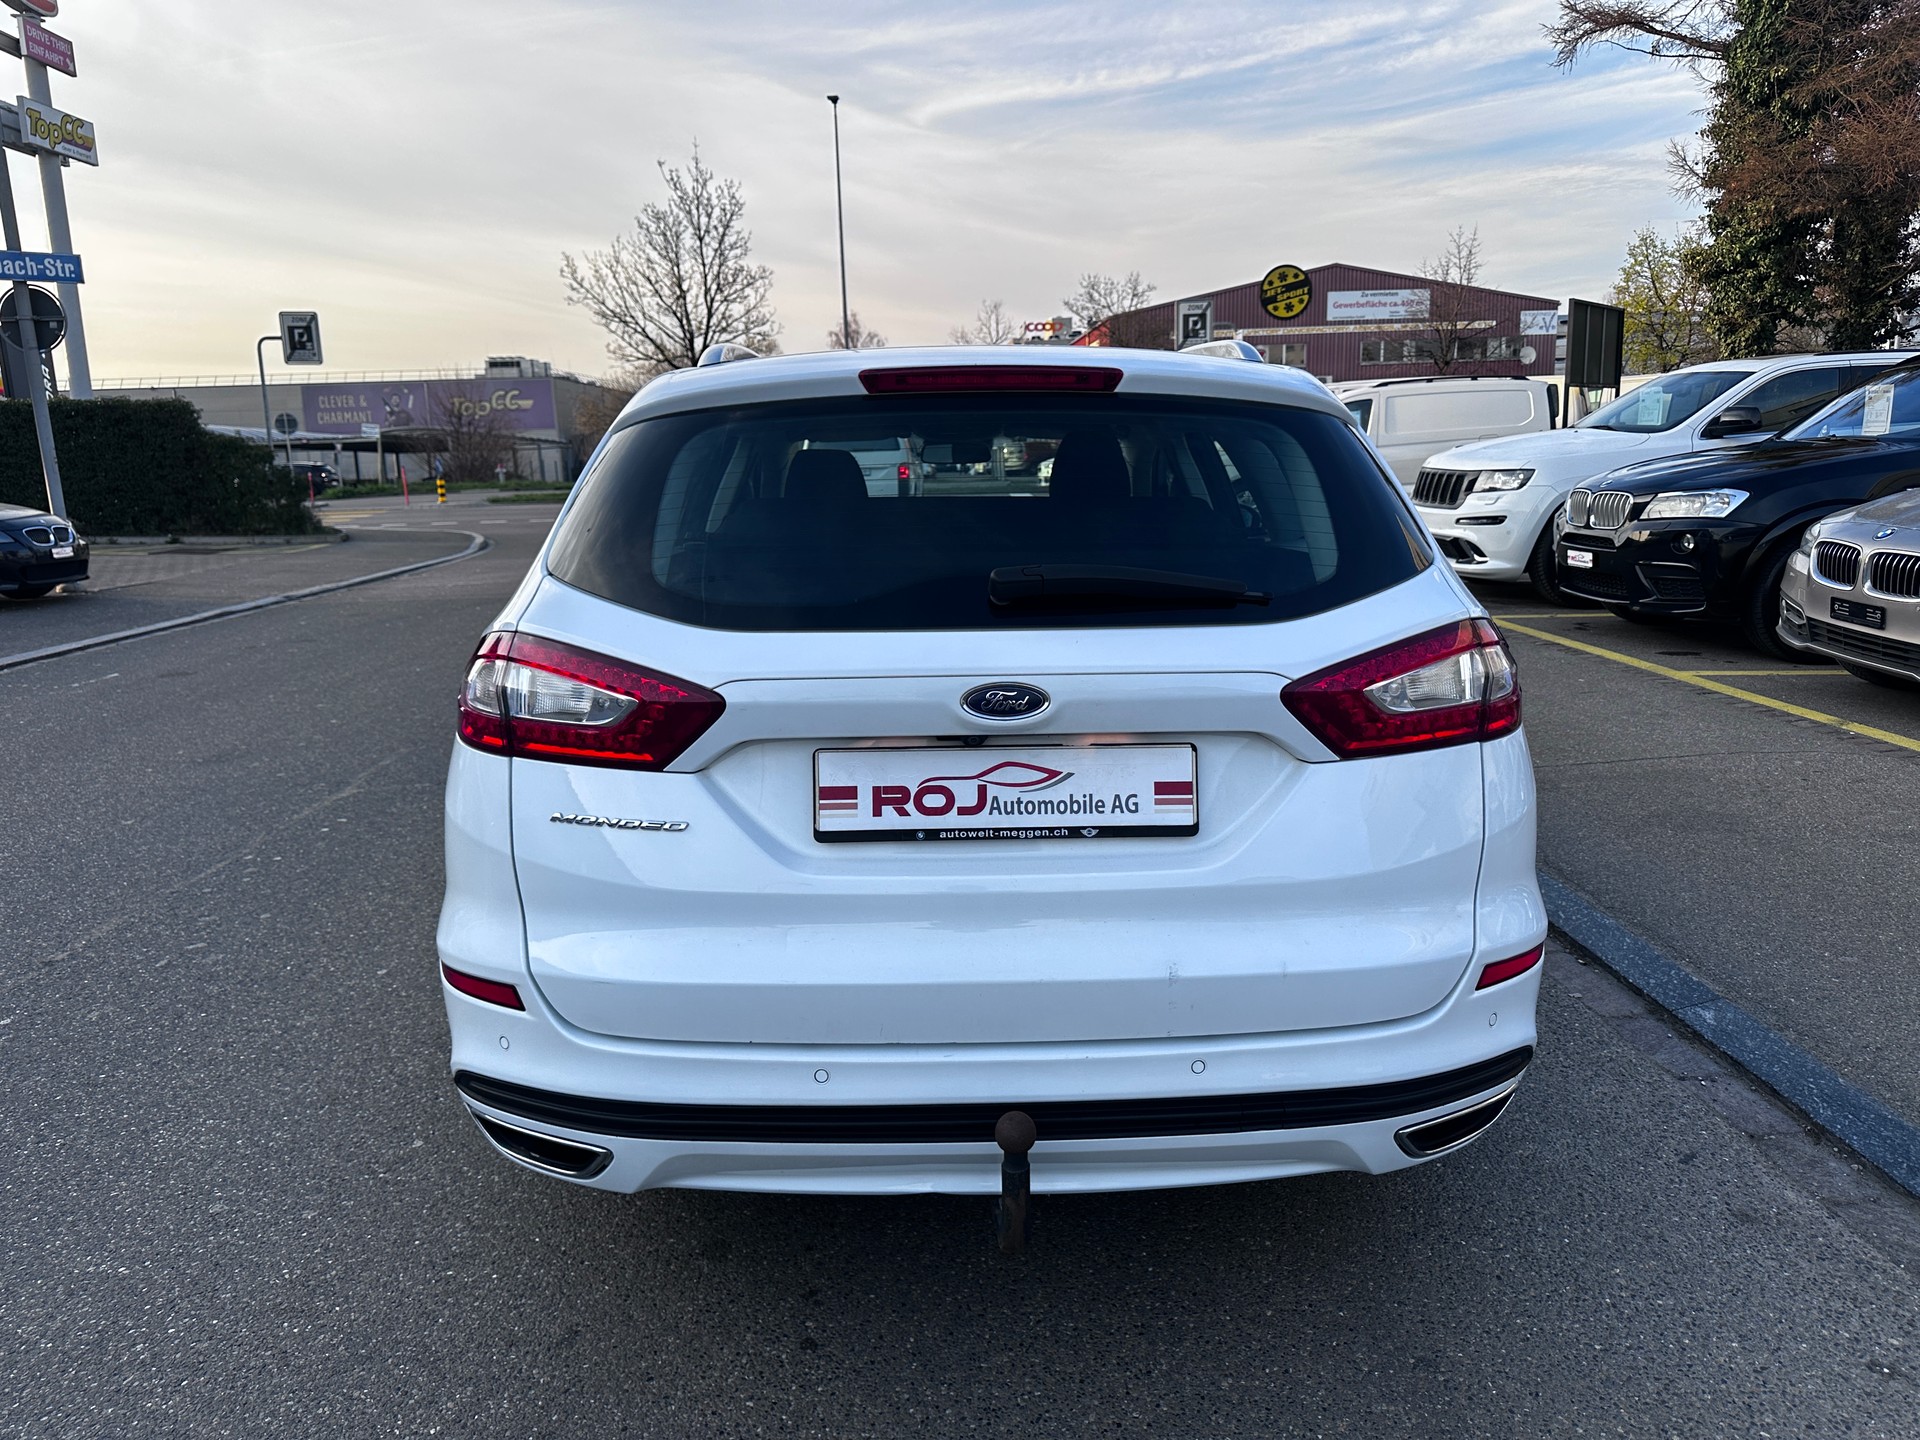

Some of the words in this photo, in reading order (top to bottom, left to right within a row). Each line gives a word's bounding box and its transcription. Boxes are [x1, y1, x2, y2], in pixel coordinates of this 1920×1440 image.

[26, 25, 50, 44] DRIVE
[50, 37, 71, 55] THRU
[29, 41, 64, 66] EINFAHRT
[26, 107, 85, 149] TopCC
[1276, 286, 1309, 301] SPORT
[1333, 300, 1388, 309] Gewerbefläche
[318, 394, 356, 409] CLEVER
[359, 394, 368, 408] &
[450, 389, 520, 420] TopCC
[317, 410, 372, 425] CHARMANT
[981, 690, 1029, 711] Ford
[872, 784, 988, 817] ROJ
[988, 793, 1106, 816] Automobile
[1110, 793, 1139, 815] AG
[550, 812, 690, 832] MONDEO
[939, 828, 1069, 839] autowelt-meggen.ch
